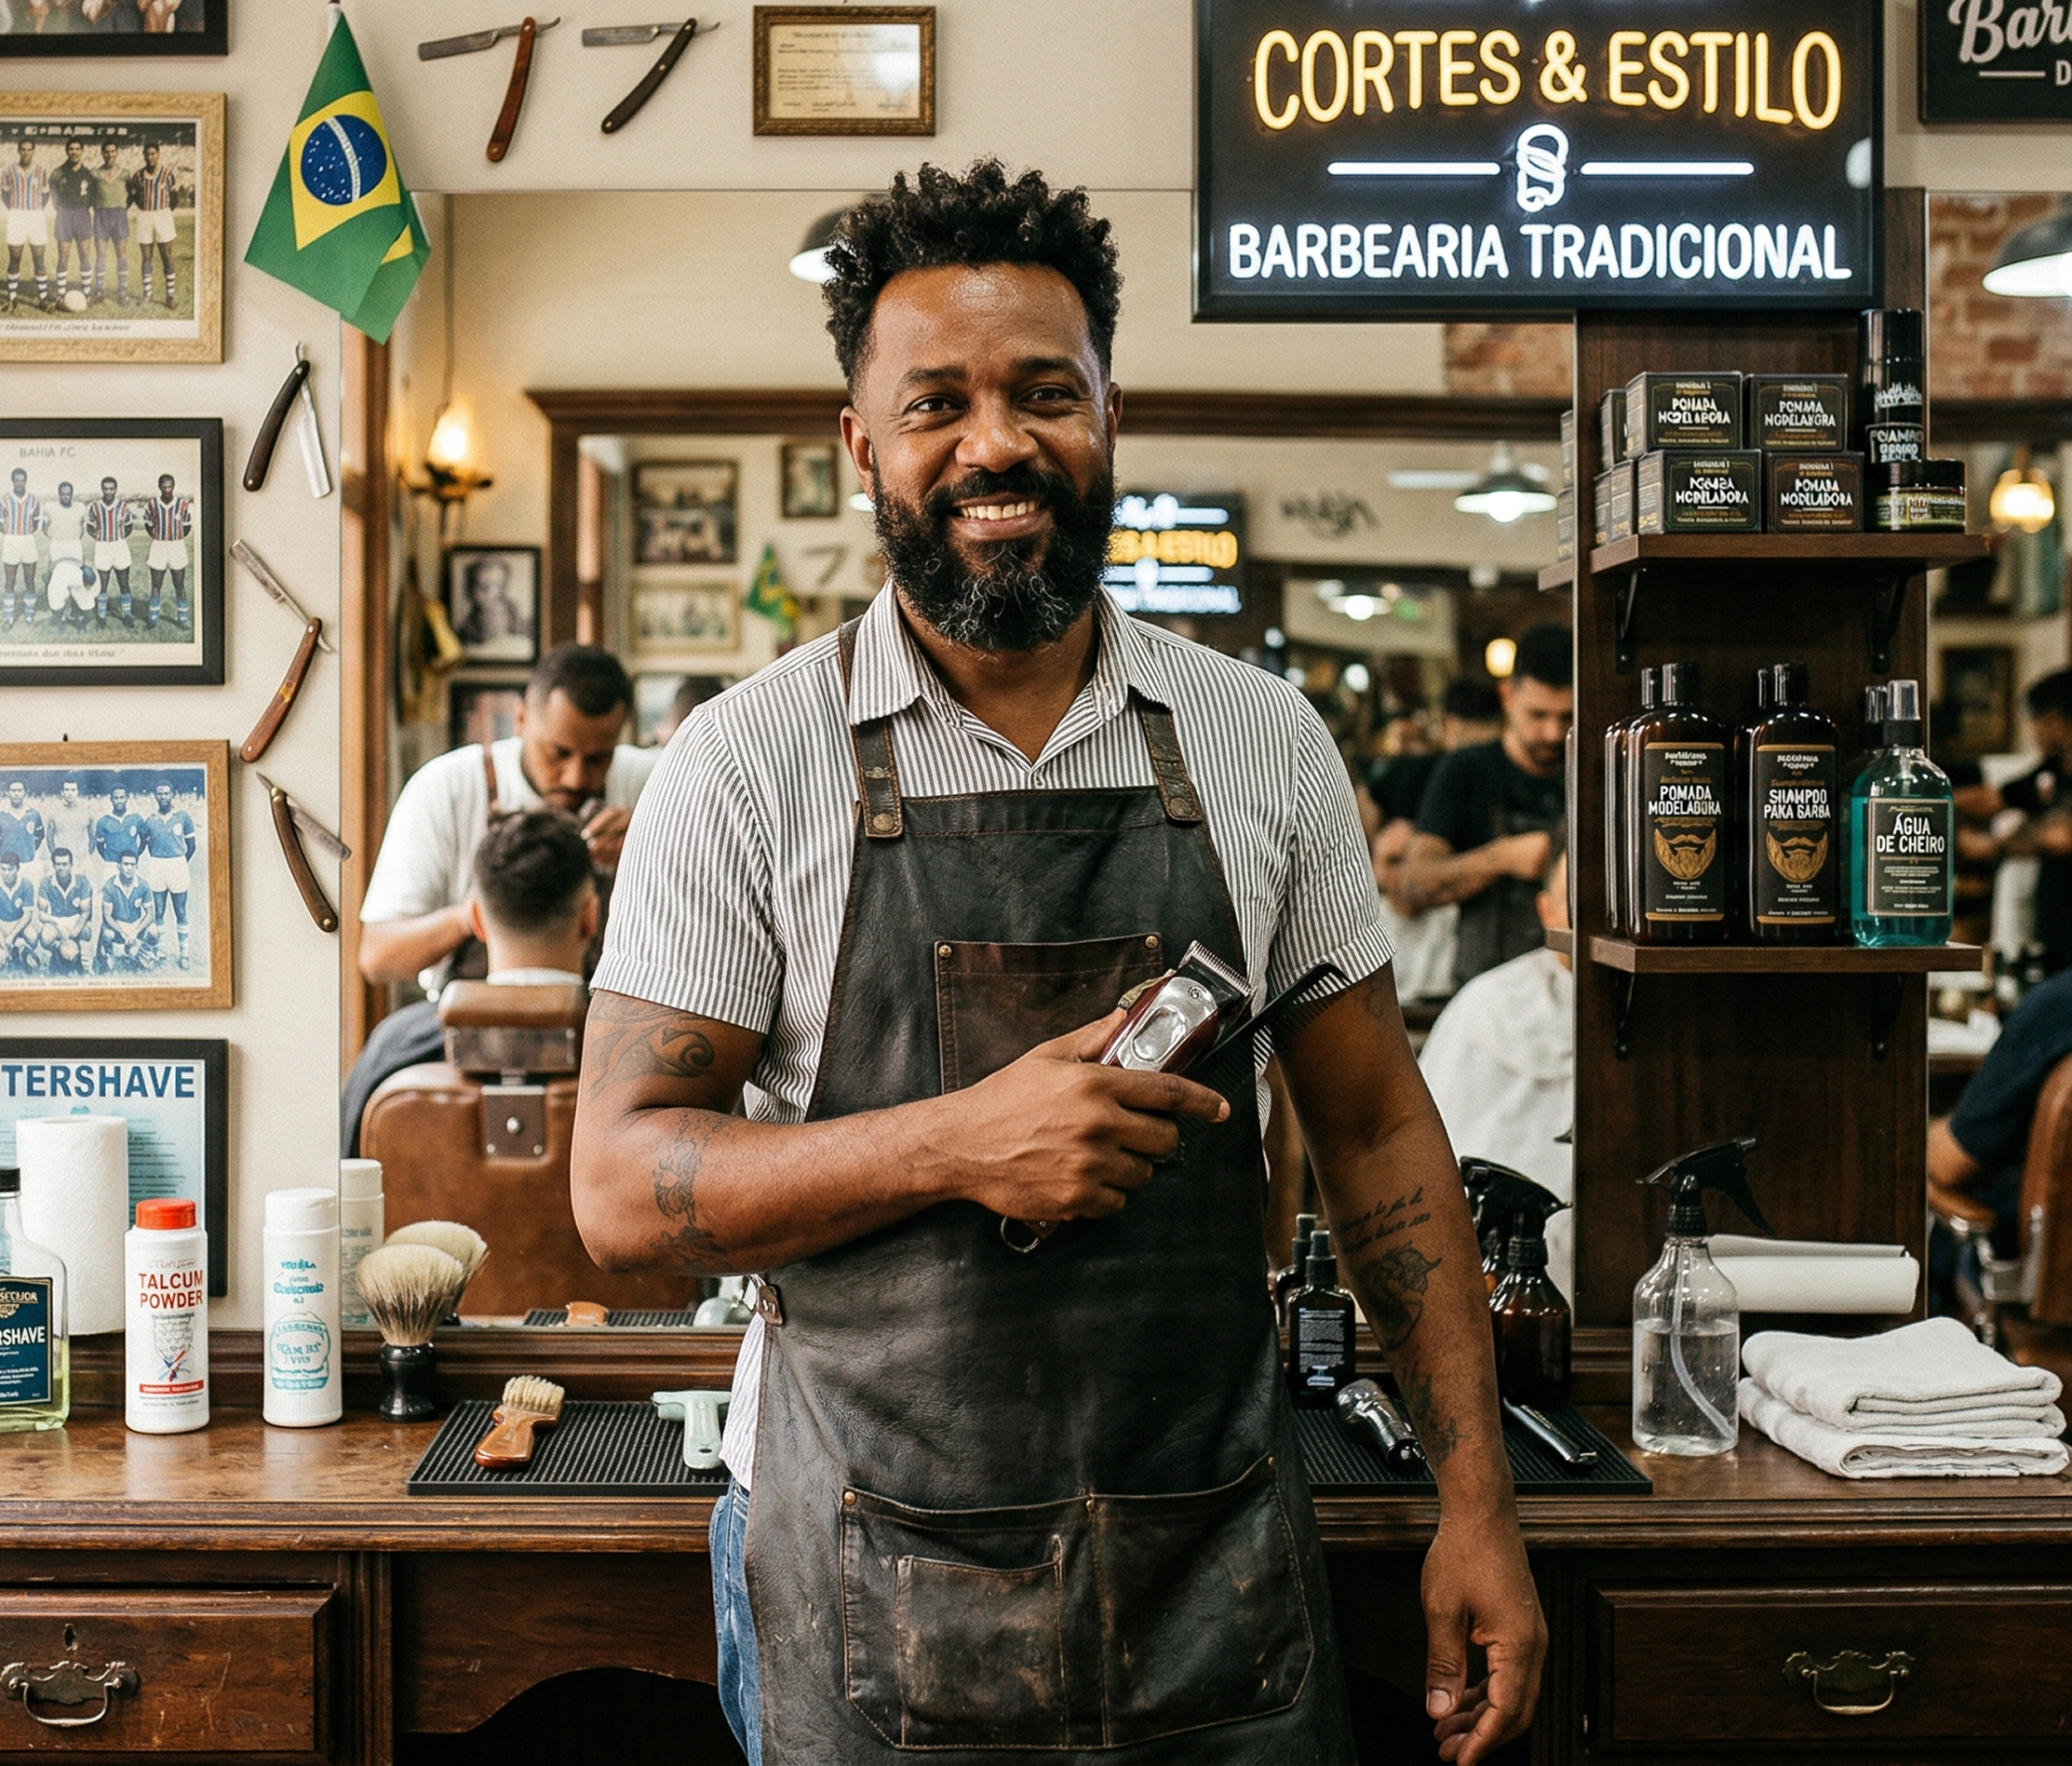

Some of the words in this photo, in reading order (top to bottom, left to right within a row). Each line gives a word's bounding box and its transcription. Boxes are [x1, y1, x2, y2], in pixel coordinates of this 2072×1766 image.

[1948, 0, 2072, 63] Bar
[1254, 30, 1521, 130] CORTES
[1539, 30, 1588, 103] &
[1608, 30, 1842, 130] ESTILO
[1229, 222, 1510, 279] BARBEARIA
[1519, 222, 1852, 280] TRADICIONAL
[1660, 785, 1712, 801] POMADA
[1892, 812, 1931, 836] ÁGUA
[1876, 835, 1895, 853] DE
[1899, 835, 1945, 854] CHEIRO
[1, 1064, 195, 1099] TERSHAVE
[139, 1270, 204, 1290] TALCUM
[140, 1289, 203, 1310] POWDER
